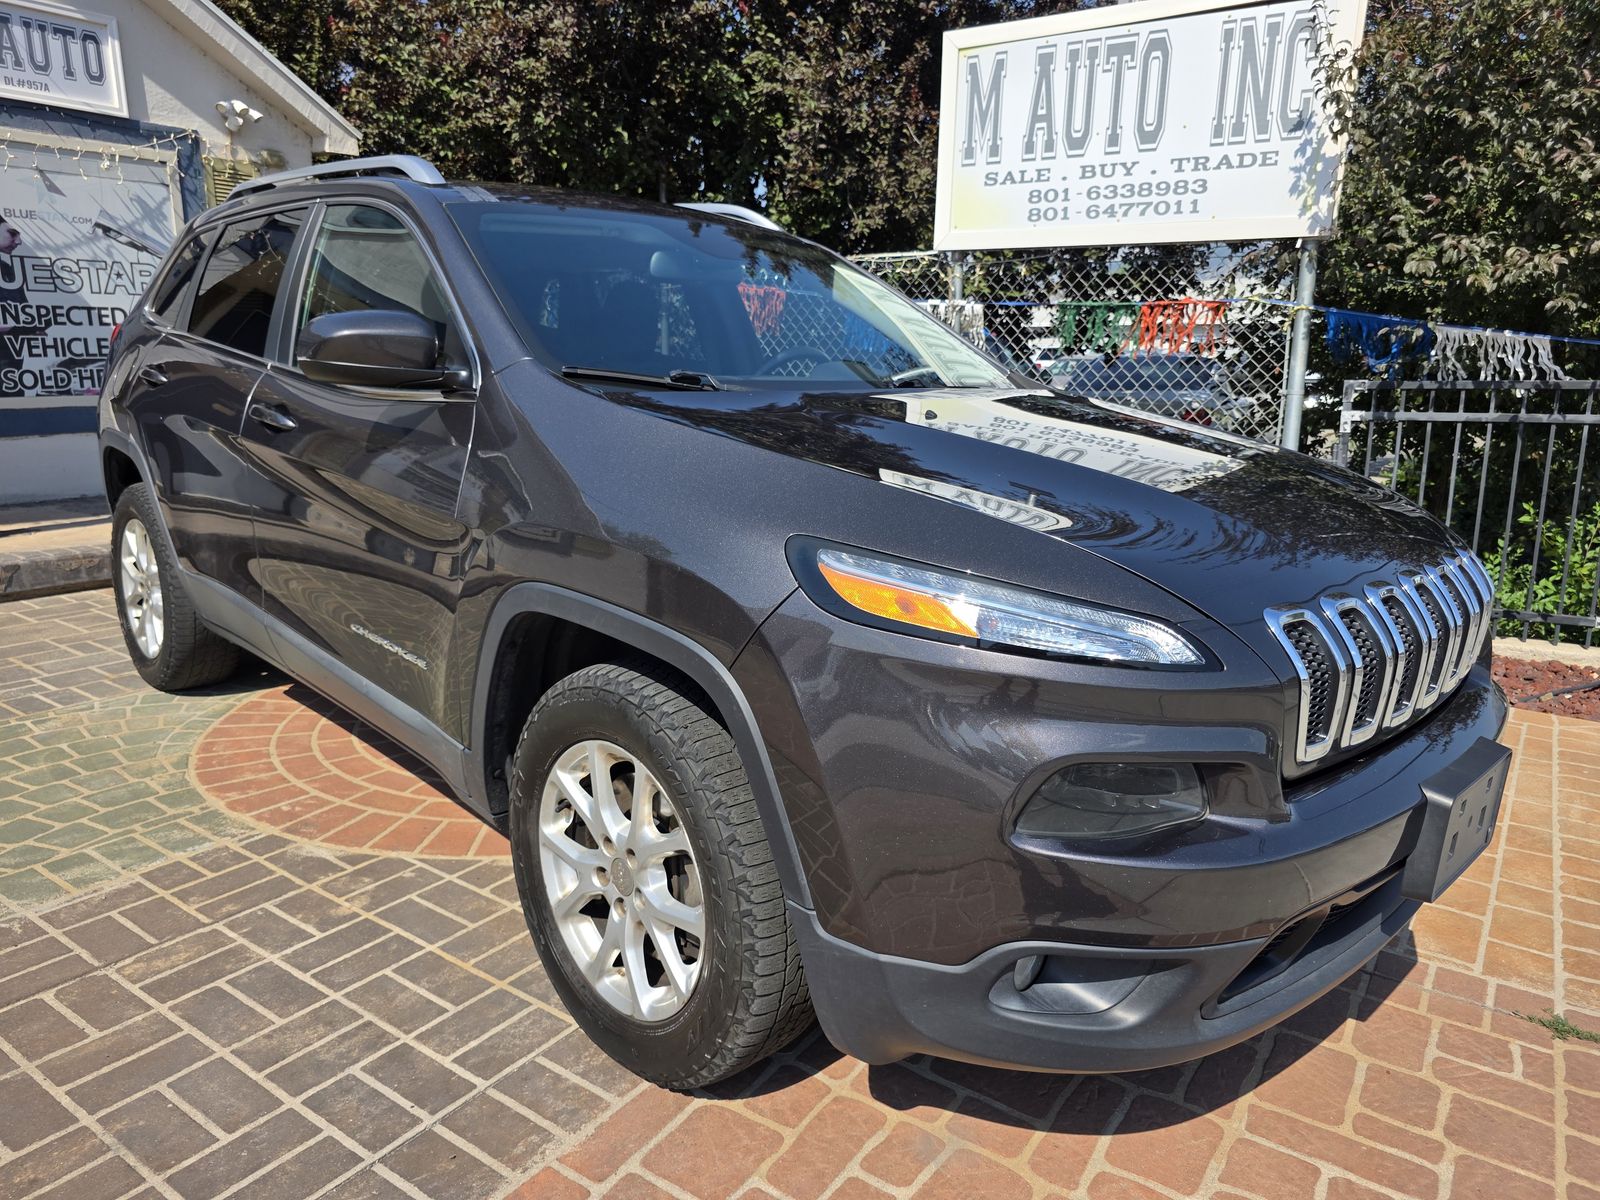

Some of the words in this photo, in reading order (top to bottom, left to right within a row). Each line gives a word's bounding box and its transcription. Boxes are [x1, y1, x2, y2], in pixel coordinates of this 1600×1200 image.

[0, 12, 106, 86] AUTO
[4, 76, 50, 93] DL#957A
[961, 50, 1008, 167] M
[1021, 28, 1173, 163] AUTO
[1209, 9, 1320, 147] INC
[983, 168, 1051, 187] SALE
[1078, 161, 1140, 180] BUY
[1170, 150, 1280, 174] TRADE
[1027, 178, 1209, 205] 801-6338983
[1026, 198, 1200, 223] 801-6477011
[3, 368, 73, 392] SOLD
